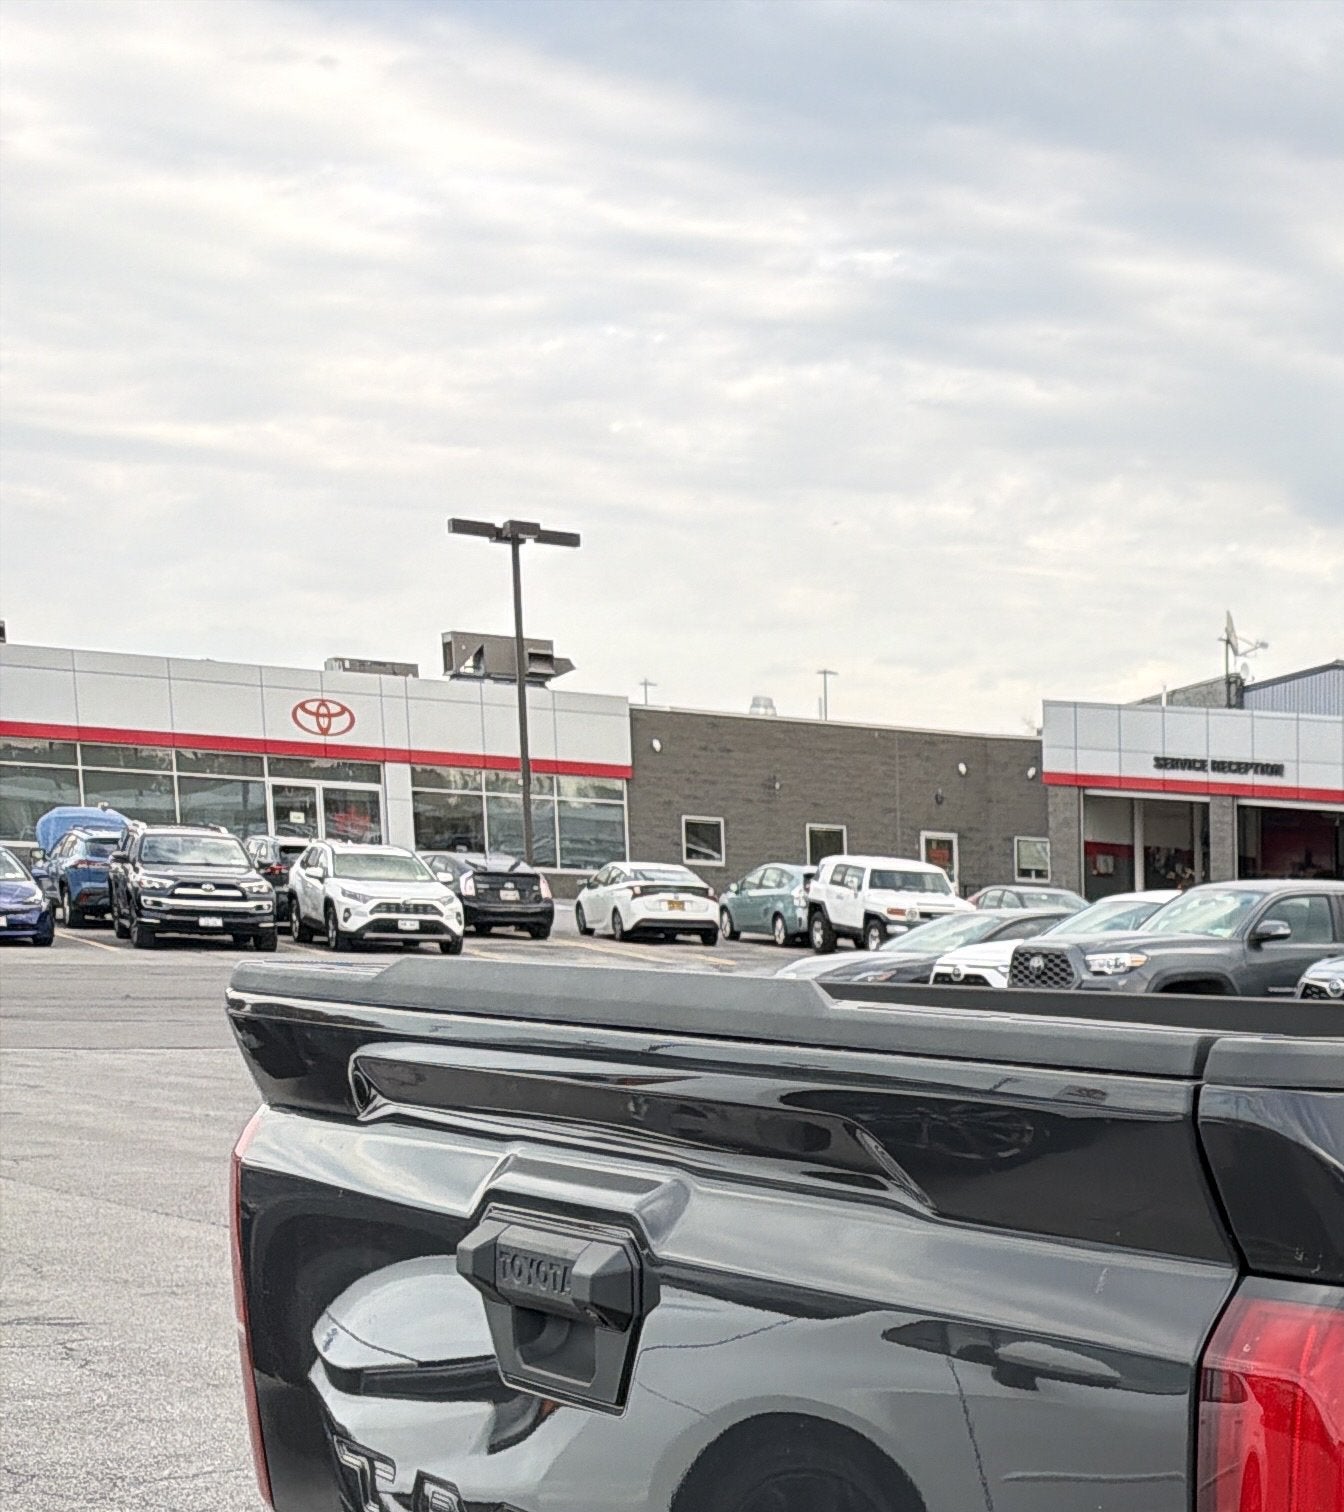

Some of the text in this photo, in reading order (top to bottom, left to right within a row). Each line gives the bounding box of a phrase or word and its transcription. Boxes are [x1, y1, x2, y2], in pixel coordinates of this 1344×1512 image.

[1153, 756, 1284, 777] SERVICE RECEPTION
[499, 1250, 572, 1296] TOYOTA
